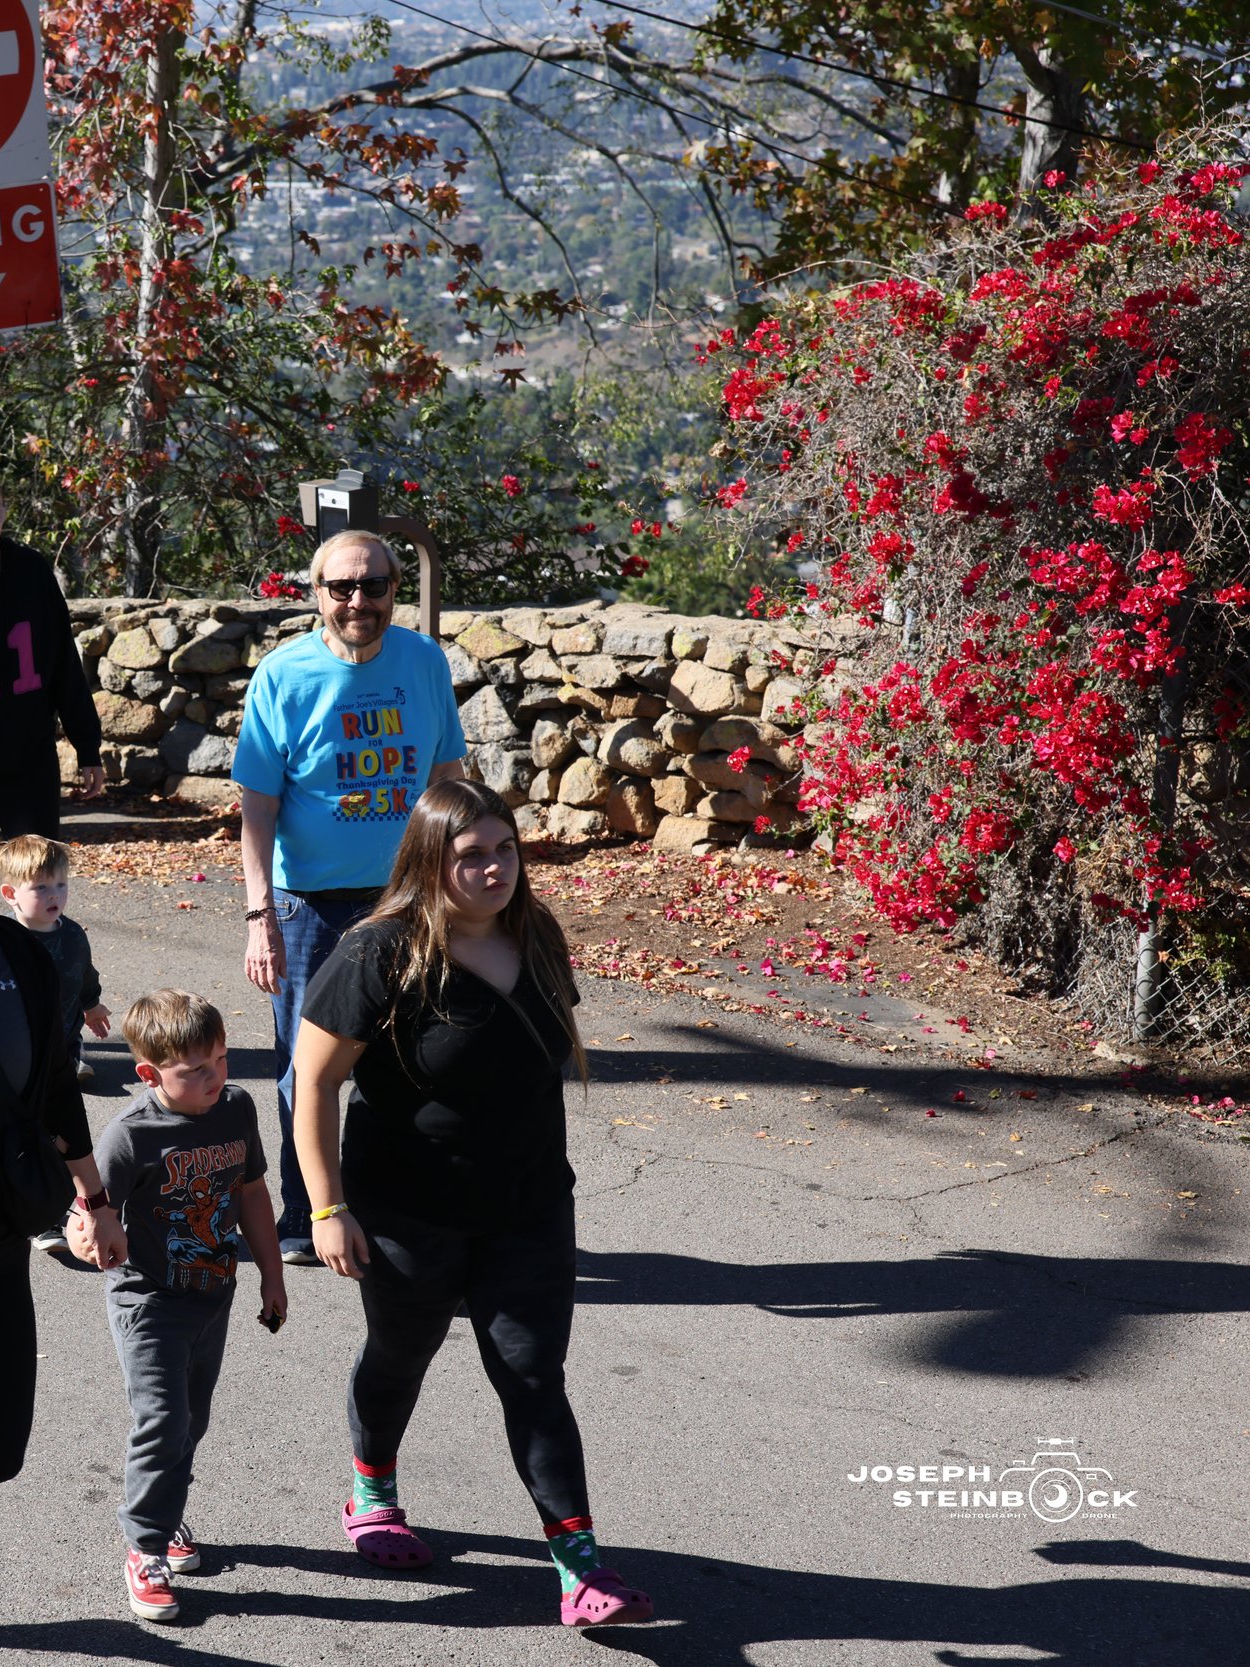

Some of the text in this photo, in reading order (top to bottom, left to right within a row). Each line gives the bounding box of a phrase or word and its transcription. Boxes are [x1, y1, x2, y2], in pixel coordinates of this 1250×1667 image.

[333, 701, 355, 712] Father
[355, 700, 372, 710] Joe's
[341, 708, 403, 740] RUN
[368, 739, 383, 747] FOR
[336, 745, 417, 779] HOPE
[336, 776, 417, 791] Thanksgiving Day
[376, 787, 411, 814] 5K
